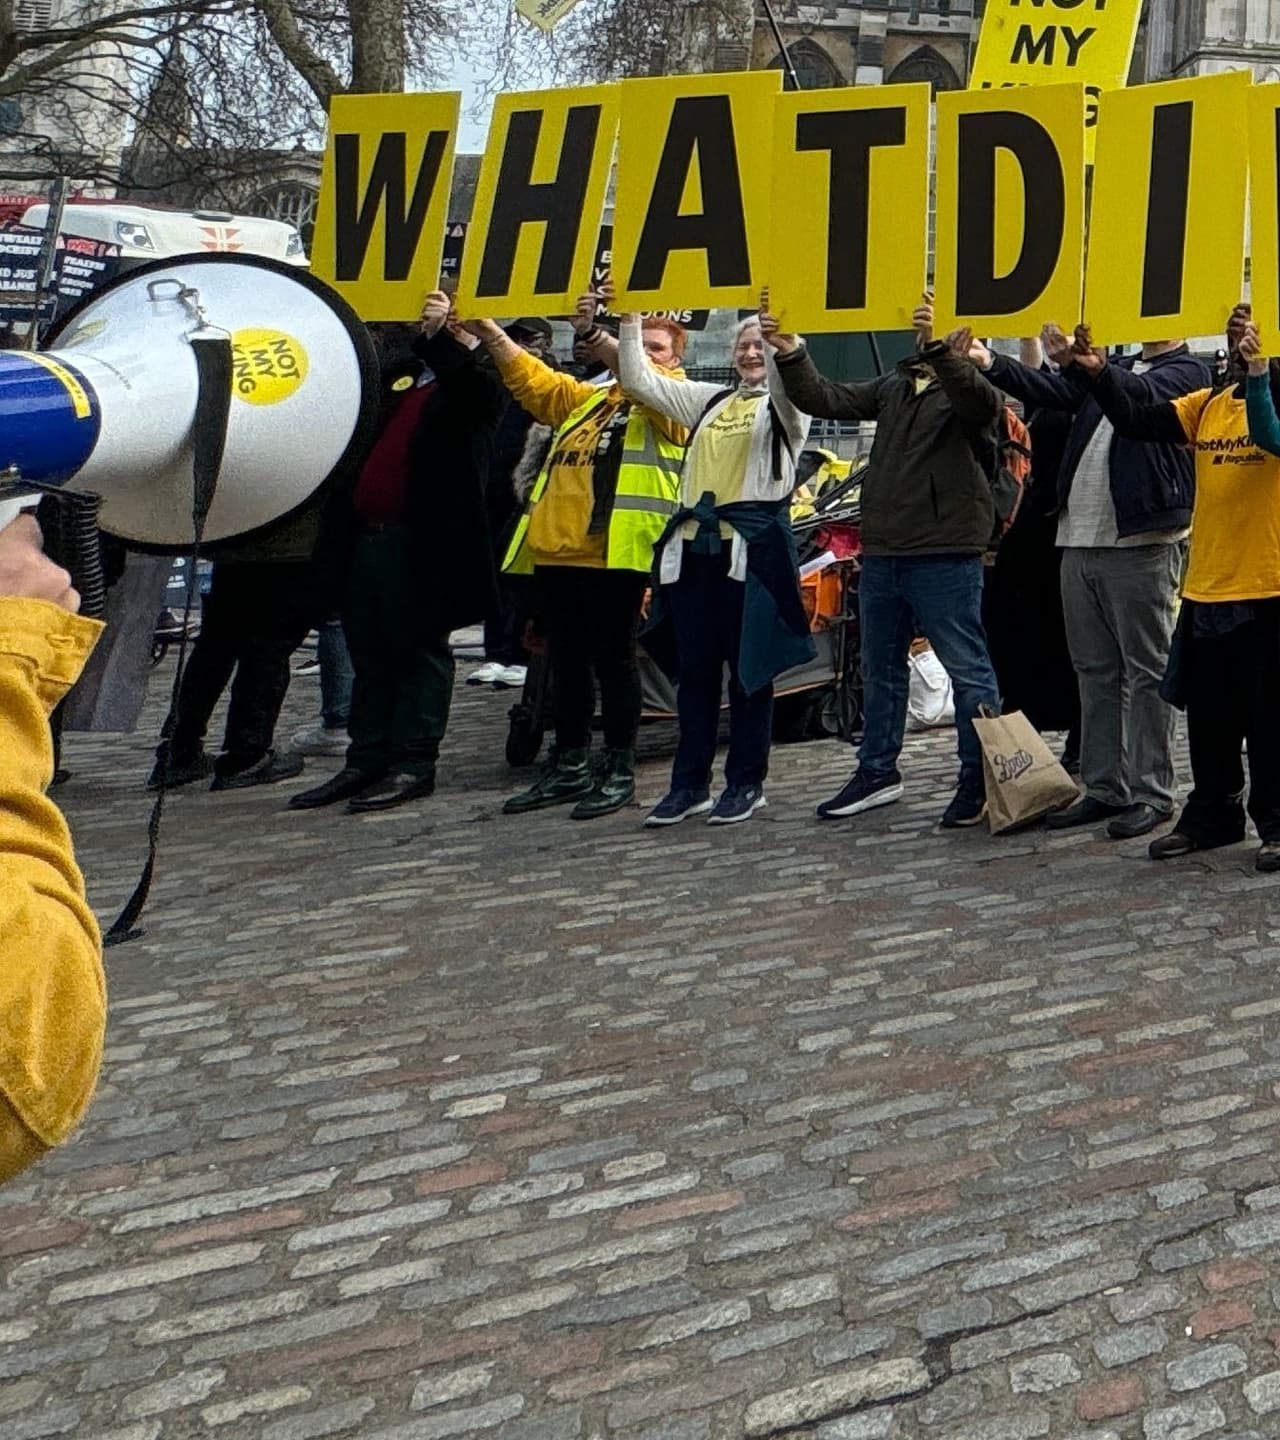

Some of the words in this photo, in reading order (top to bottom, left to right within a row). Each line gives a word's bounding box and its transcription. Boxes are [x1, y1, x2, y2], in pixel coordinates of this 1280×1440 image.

[1010, 24, 1097, 66] MY
[232, 343, 257, 395] KING
[249, 348, 278, 379] MY
[269, 339, 300, 380] NOT
